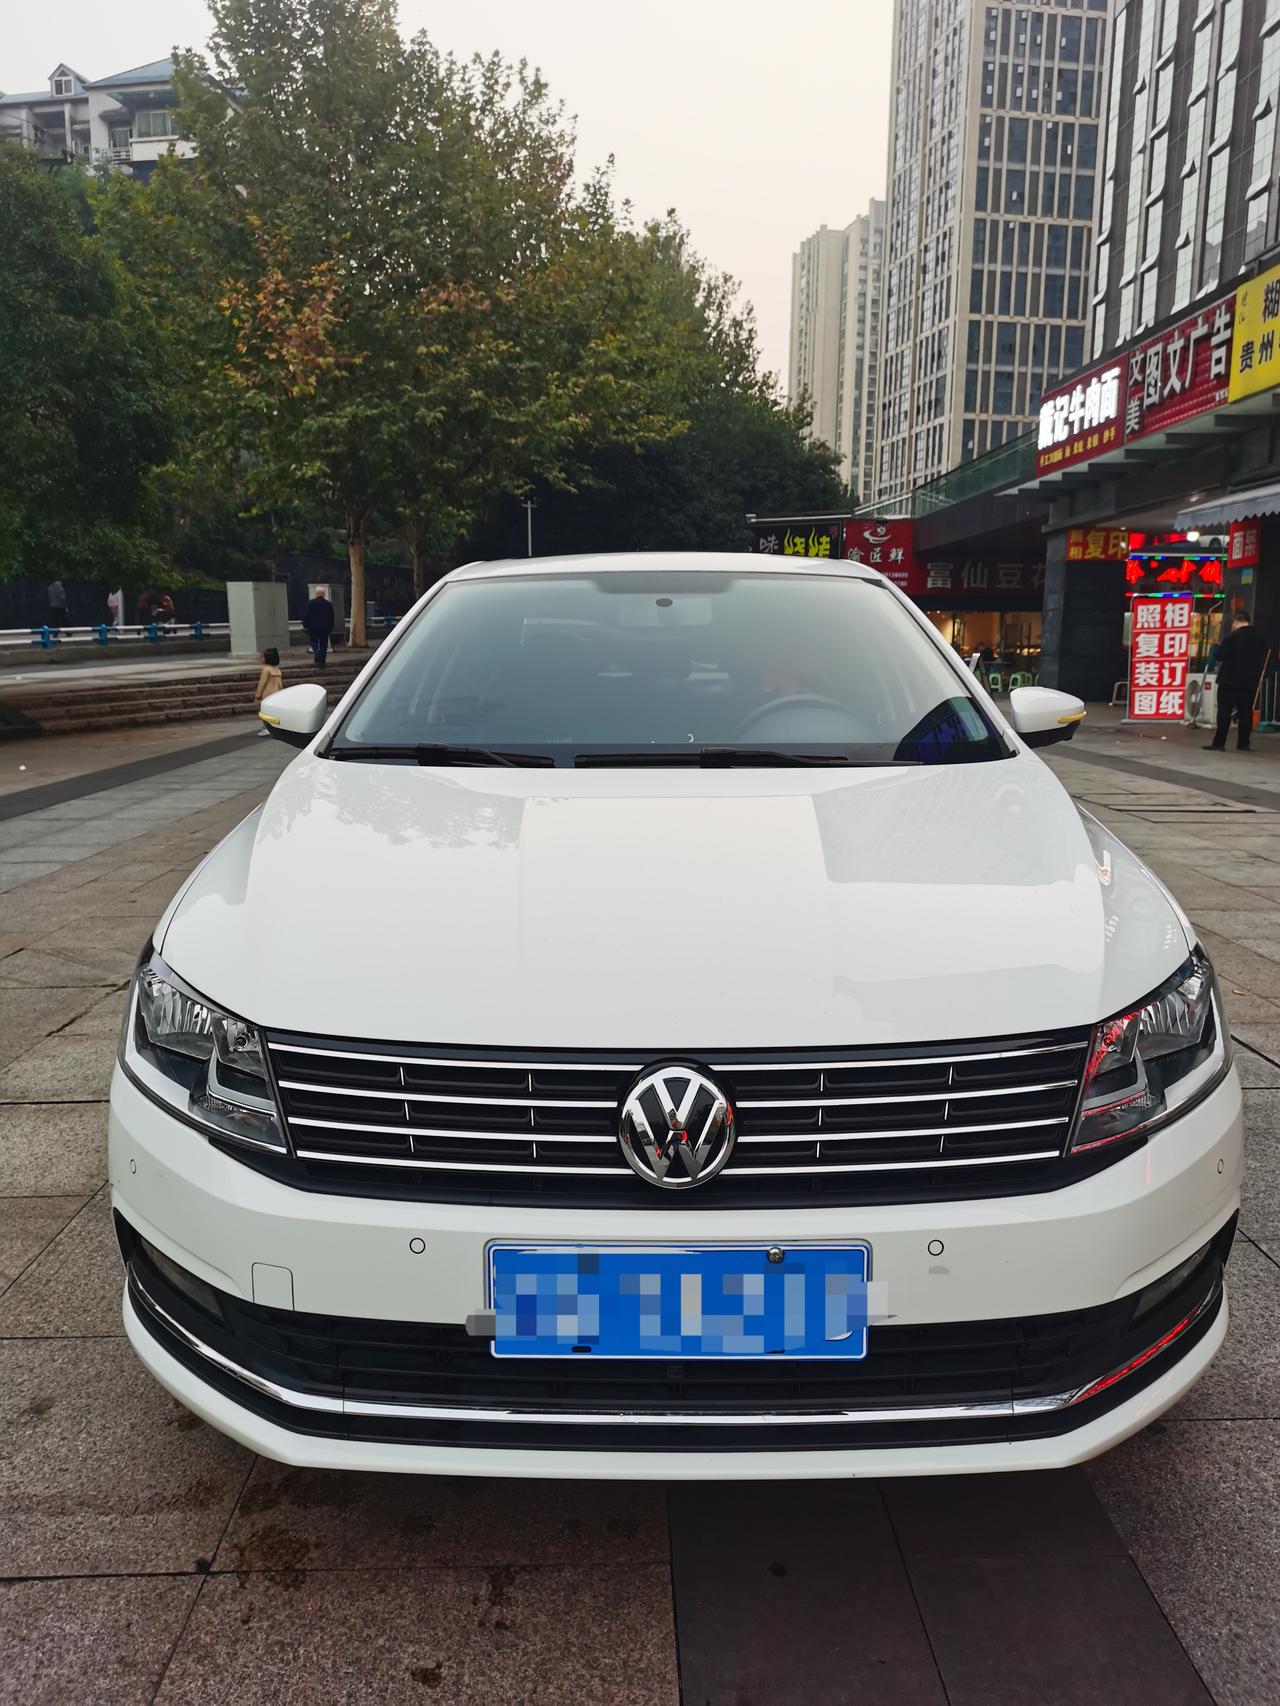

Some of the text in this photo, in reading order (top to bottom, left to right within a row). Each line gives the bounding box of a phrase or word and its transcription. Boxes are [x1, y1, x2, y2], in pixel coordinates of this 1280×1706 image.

[1144, 303, 1232, 410] 图文广告
[1240, 329, 1280, 373] 贵州
[1084, 531, 1128, 560] 复印
[1136, 603, 1189, 629] 照相
[1135, 633, 1187, 658] 复印
[1134, 661, 1186, 687] 装订
[1133, 690, 1183, 715] 图纸
